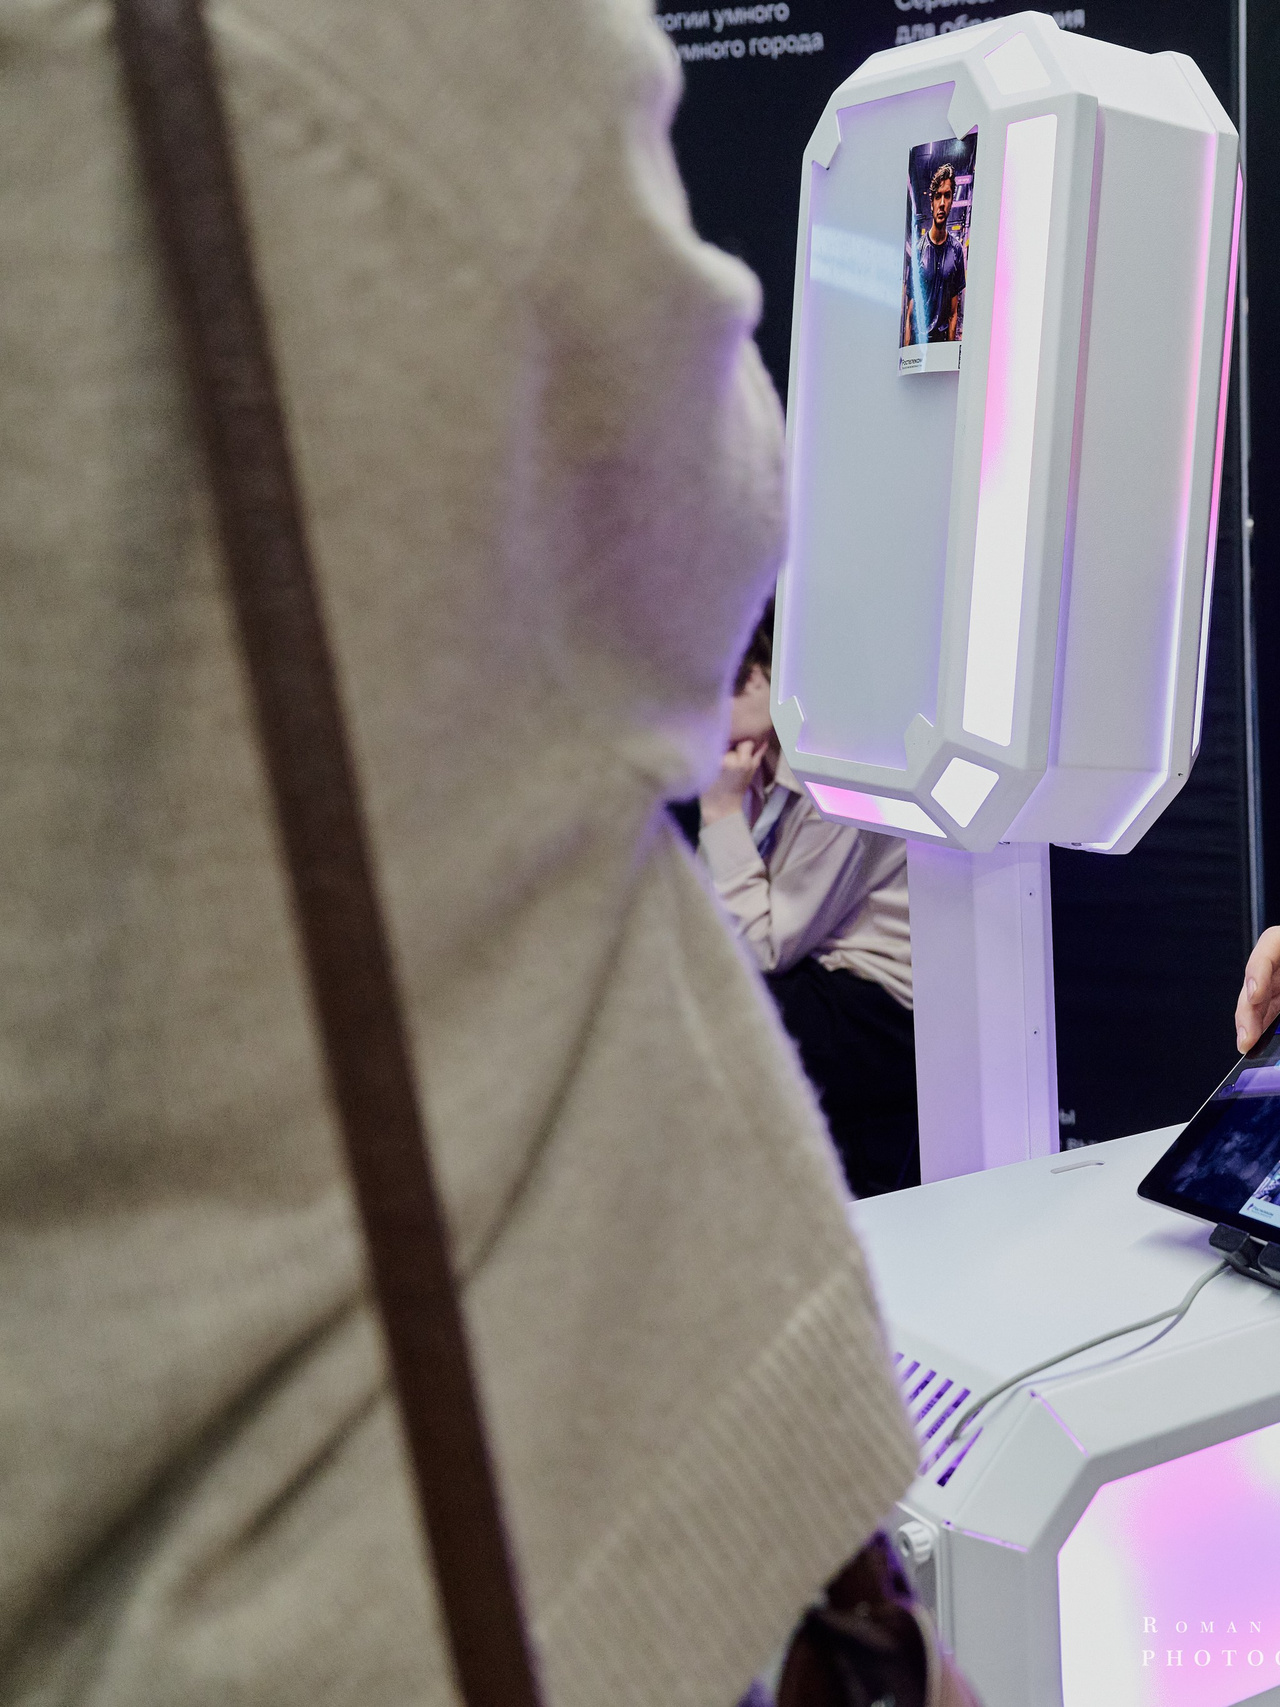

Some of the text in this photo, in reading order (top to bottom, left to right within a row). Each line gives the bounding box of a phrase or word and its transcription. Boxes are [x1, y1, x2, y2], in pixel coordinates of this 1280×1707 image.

[712, 2, 790, 33] умного
[677, 32, 824, 62] много города
